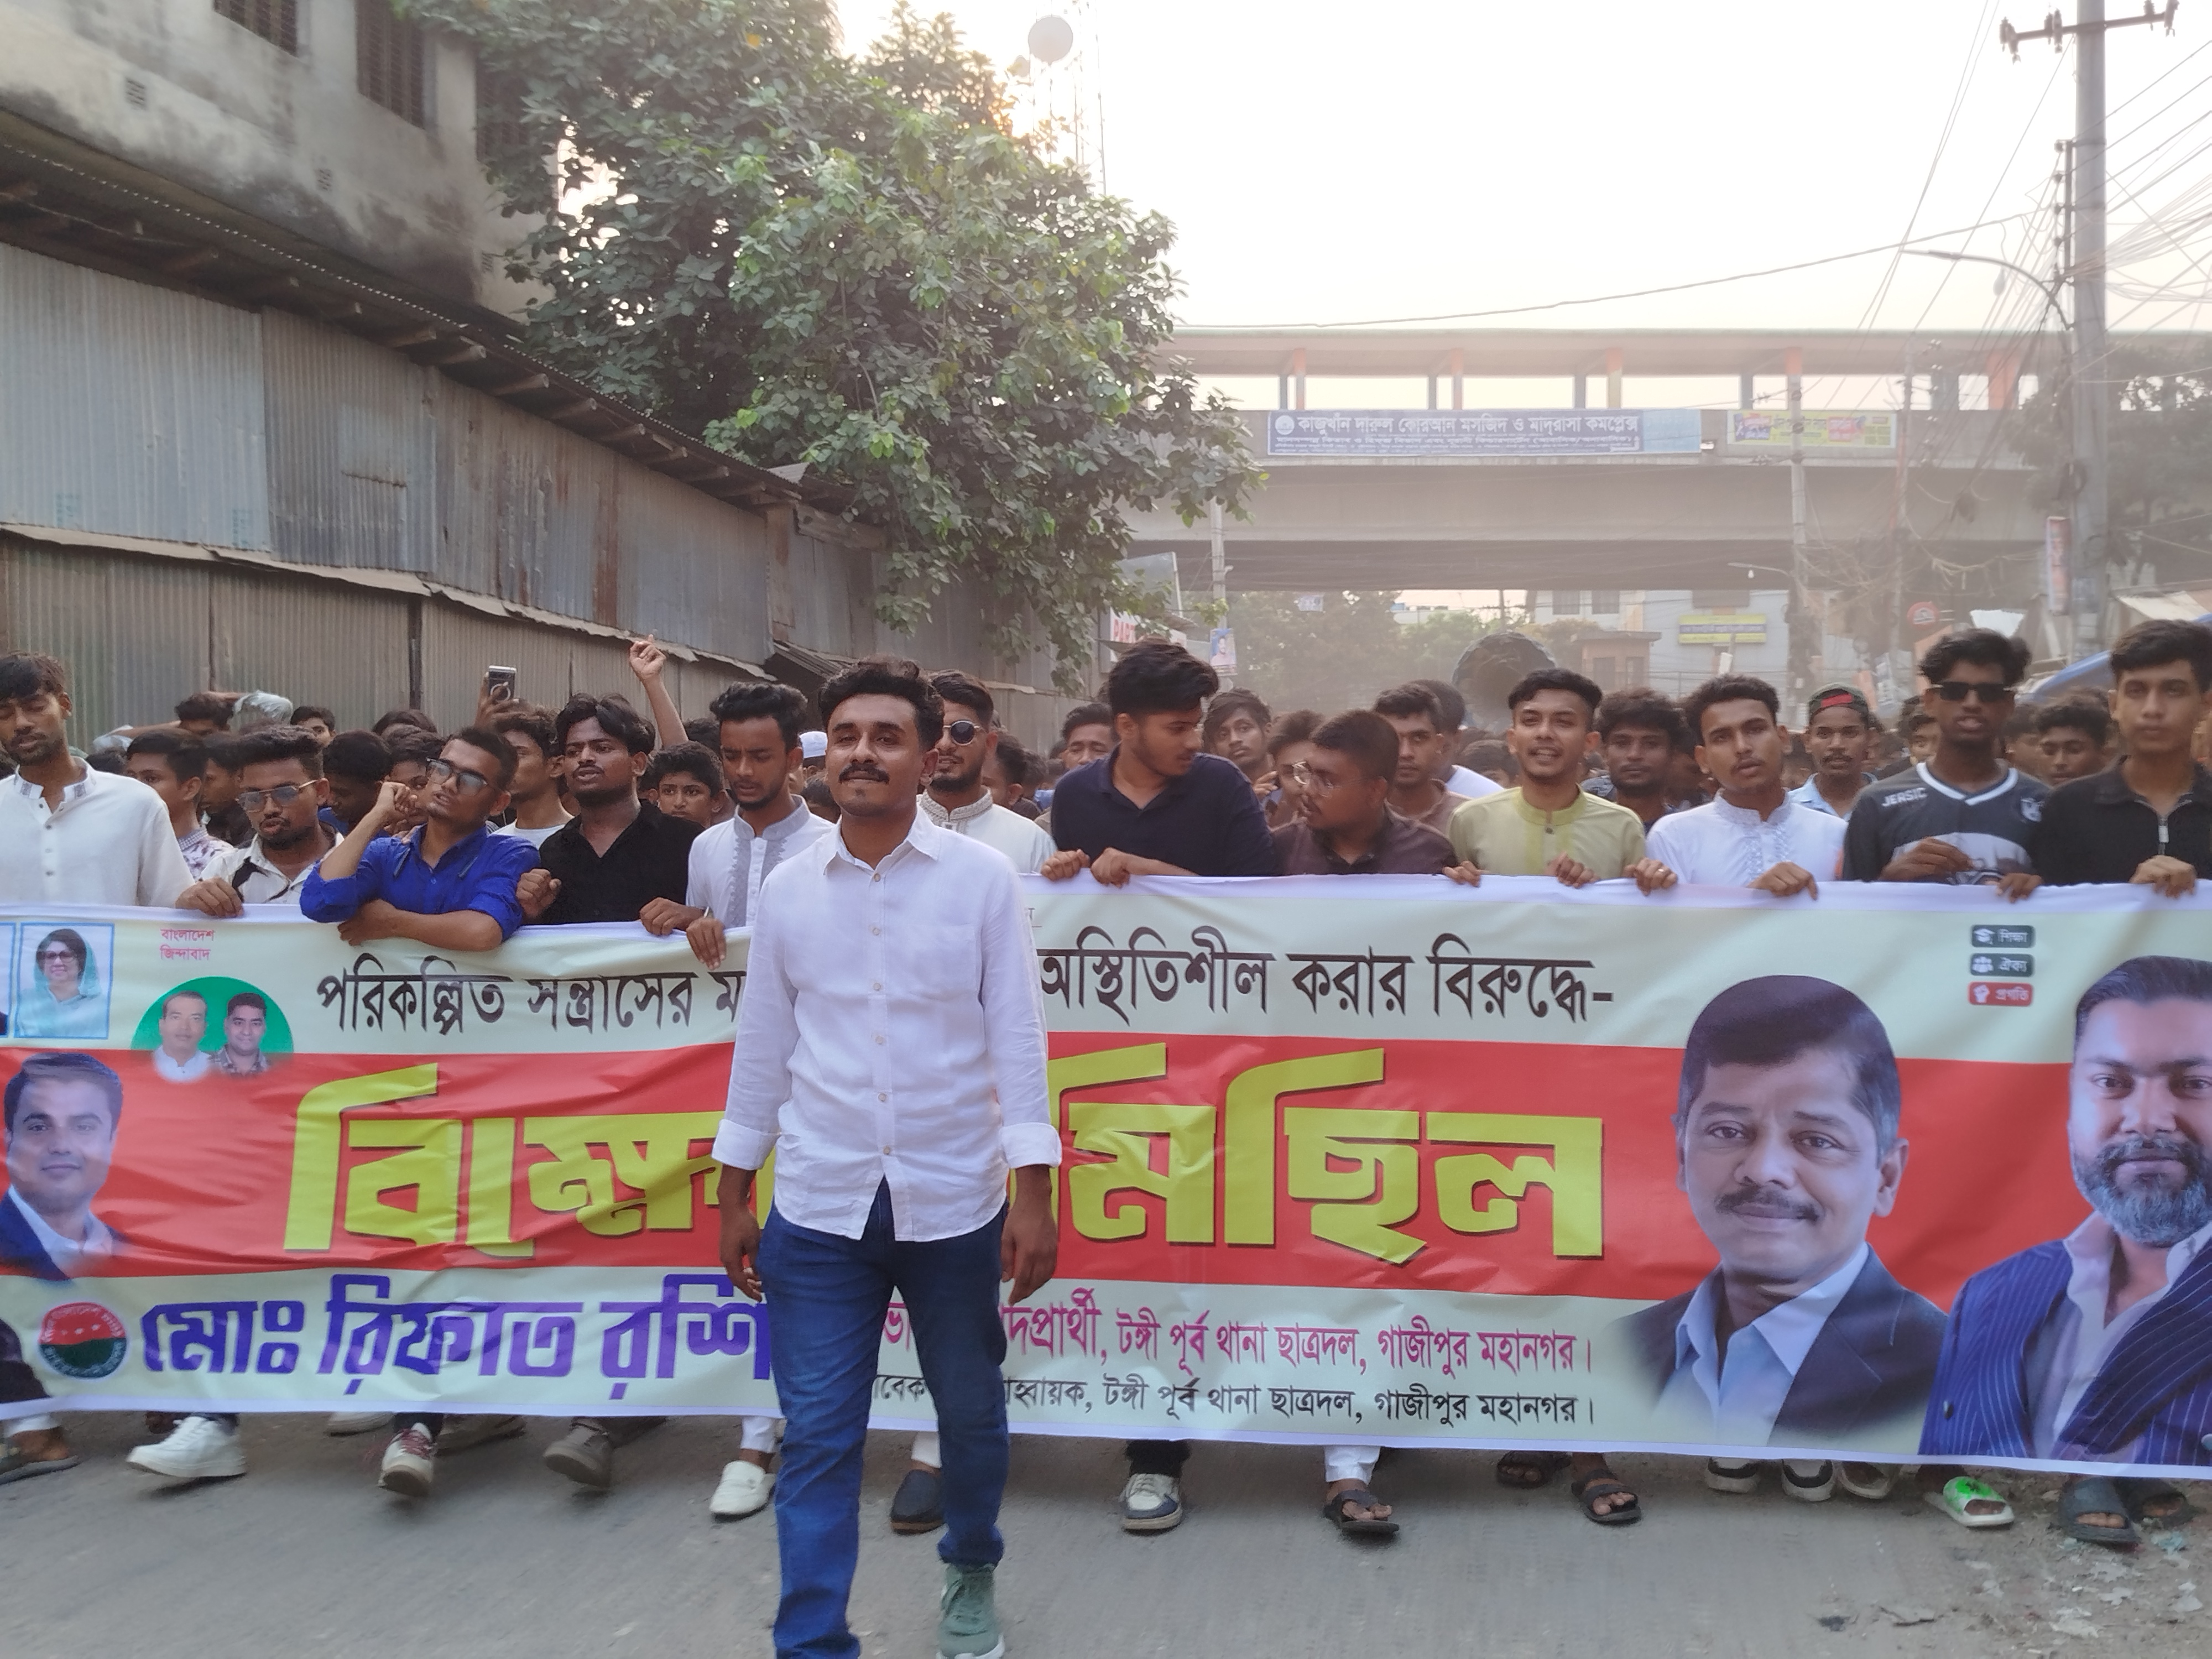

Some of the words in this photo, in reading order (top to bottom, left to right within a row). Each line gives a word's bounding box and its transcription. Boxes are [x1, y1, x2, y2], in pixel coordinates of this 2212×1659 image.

[1354, 417, 1394, 434] দারুল
[1398, 417, 1457, 434] কোরআন
[1459, 413, 1509, 434] মসজিদ
[1512, 417, 1524, 432] ও
[1583, 415, 1639, 433] কমপ্লেক্স
[159, 945, 211, 961] জিন্দাবাদ
[160, 928, 215, 942] বাংলাদেশ
[1997, 928, 2028, 943] শিক্ষা
[316, 952, 513, 1036] পরিকল্পিত
[523, 972, 699, 1034] সন্ত্রাসের
[1036, 926, 1276, 1025] অস্থিতিশীল
[1286, 946, 1414, 1016] করার
[1995, 986, 2030, 1001] প্রগতি
[1047, 1042, 1603, 1263] মিছিল
[317, 1274, 584, 1395] রিফাত
[599, 1274, 771, 1400] রশি
[1117, 1307, 1161, 1360] টঙ্গী
[1170, 1310, 1210, 1376] পূর্ব
[1217, 1320, 1267, 1364] থানা
[1274, 1323, 1367, 1376] ছাত্রদল,
[1378, 1315, 1470, 1379] গাজীপুর
[1103, 1373, 1150, 1410] টঙ্গী
[1158, 1377, 1201, 1420] পূর্ব
[1208, 1384, 1261, 1415] থানা
[1268, 1384, 1363, 1424] ছাত্রদল,
[1375, 1383, 1470, 1428] গাজীপুর
